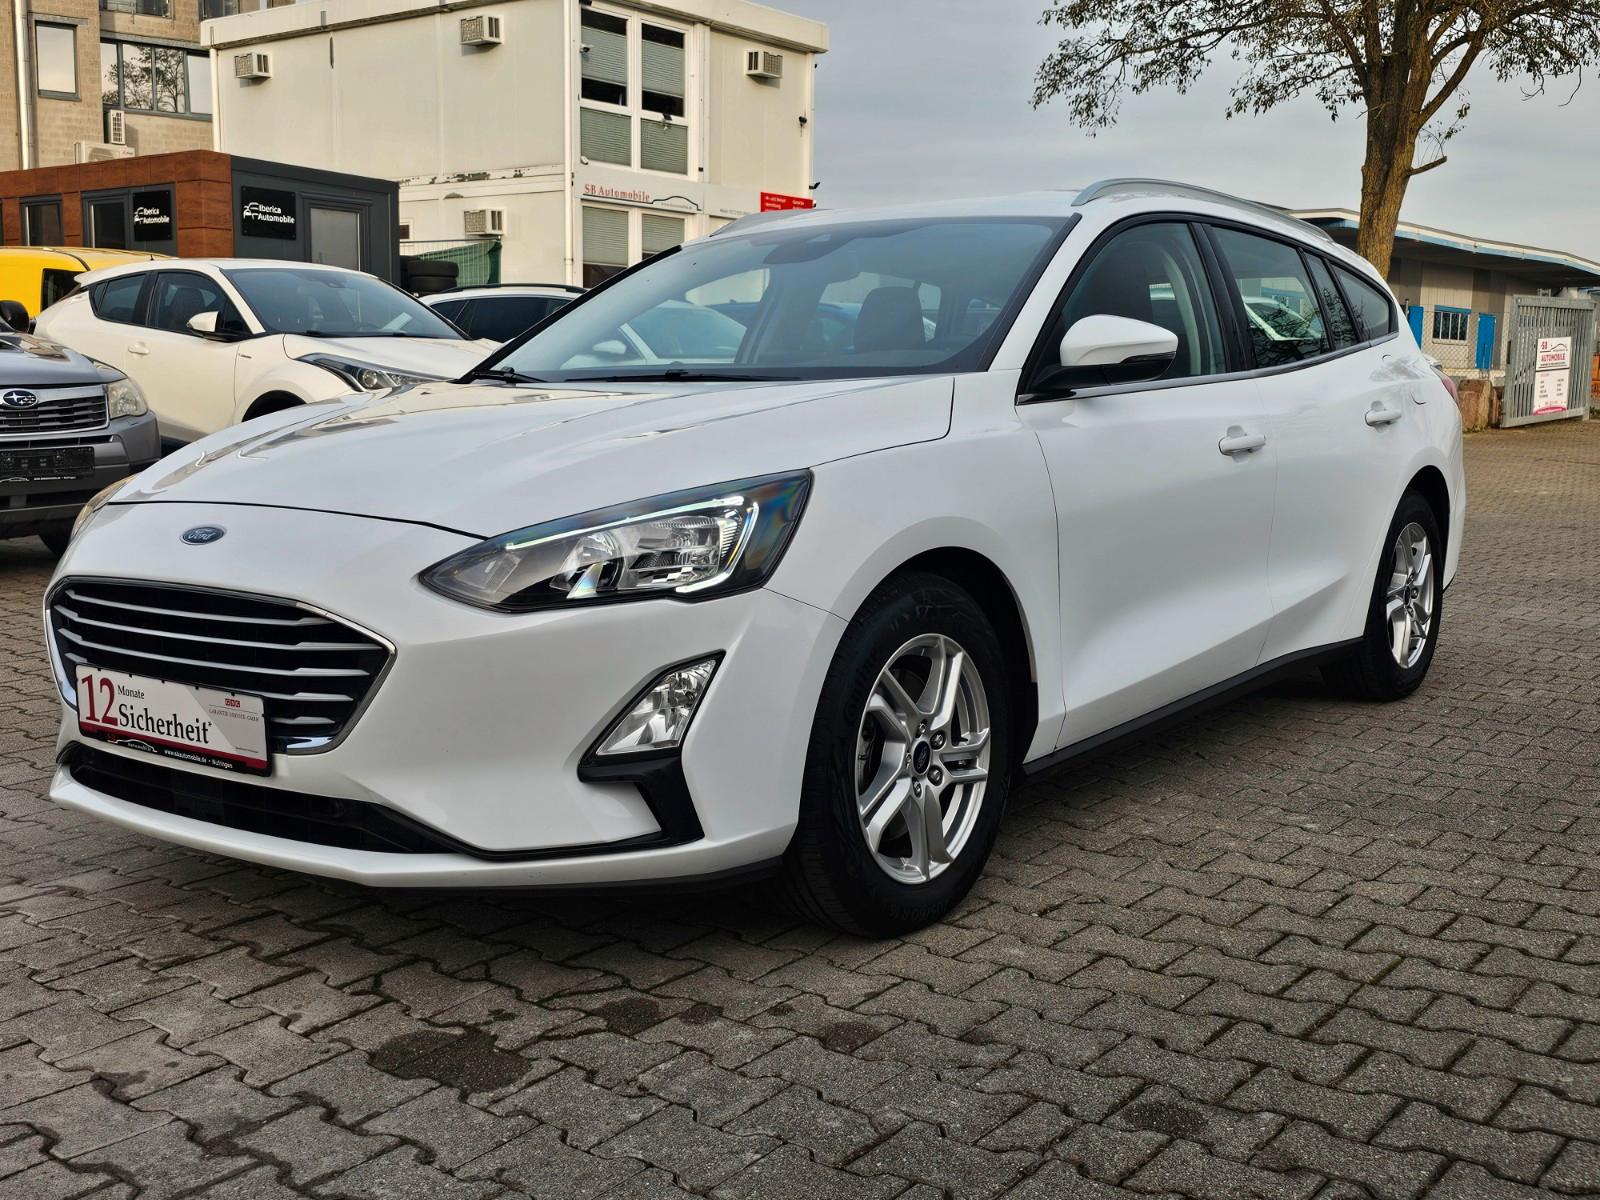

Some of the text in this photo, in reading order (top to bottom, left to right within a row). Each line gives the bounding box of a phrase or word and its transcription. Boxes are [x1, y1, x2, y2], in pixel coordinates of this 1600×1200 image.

[584, 183, 650, 202] SB Automobile
[143, 207, 160, 215] Iberica
[258, 204, 282, 214] Iberica
[143, 216, 170, 224] Automobile
[257, 212, 295, 224] Automobile
[117, 684, 145, 700] Monate
[81, 674, 118, 726] 12
